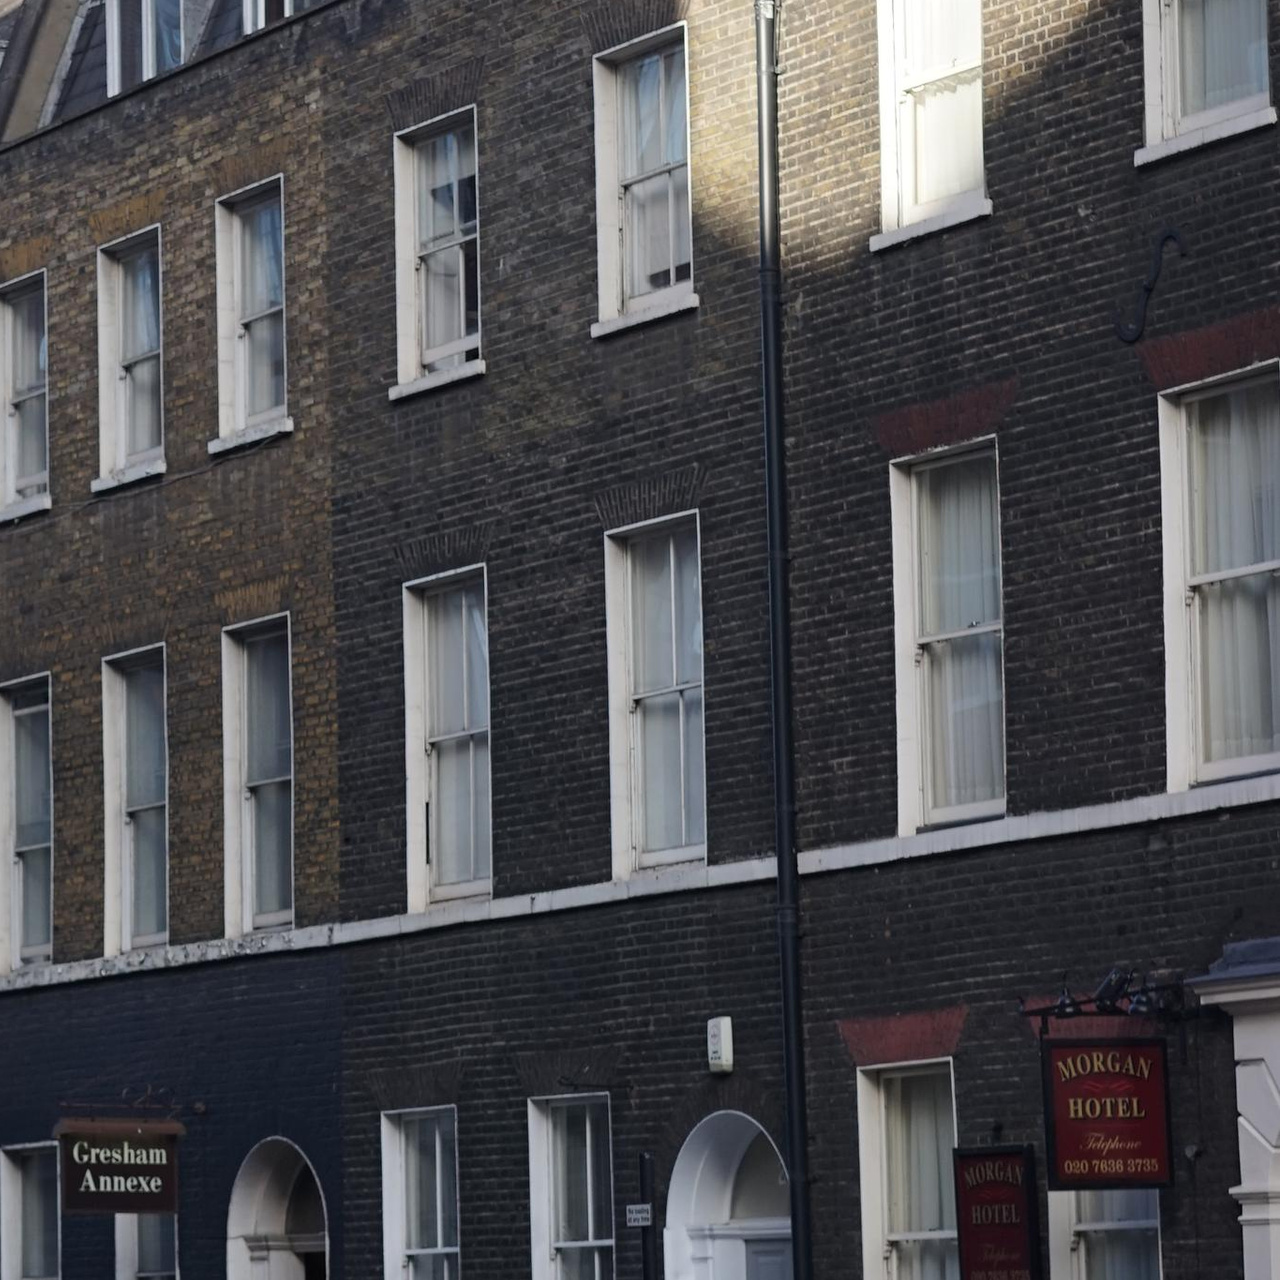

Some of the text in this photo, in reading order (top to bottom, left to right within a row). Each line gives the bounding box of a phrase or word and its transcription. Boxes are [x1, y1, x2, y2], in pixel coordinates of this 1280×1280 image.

[1056, 1051, 1152, 1081] MORGAN
[1068, 1097, 1145, 1118] HOTEL
[73, 1141, 168, 1164] Gresham
[1080, 1132, 1142, 1155] Telephone
[964, 1160, 1024, 1189] MORGAN
[1064, 1158, 1159, 1173] 020 7636 3735
[80, 1168, 163, 1193] Annexe
[971, 1203, 1021, 1225] HOTEL
